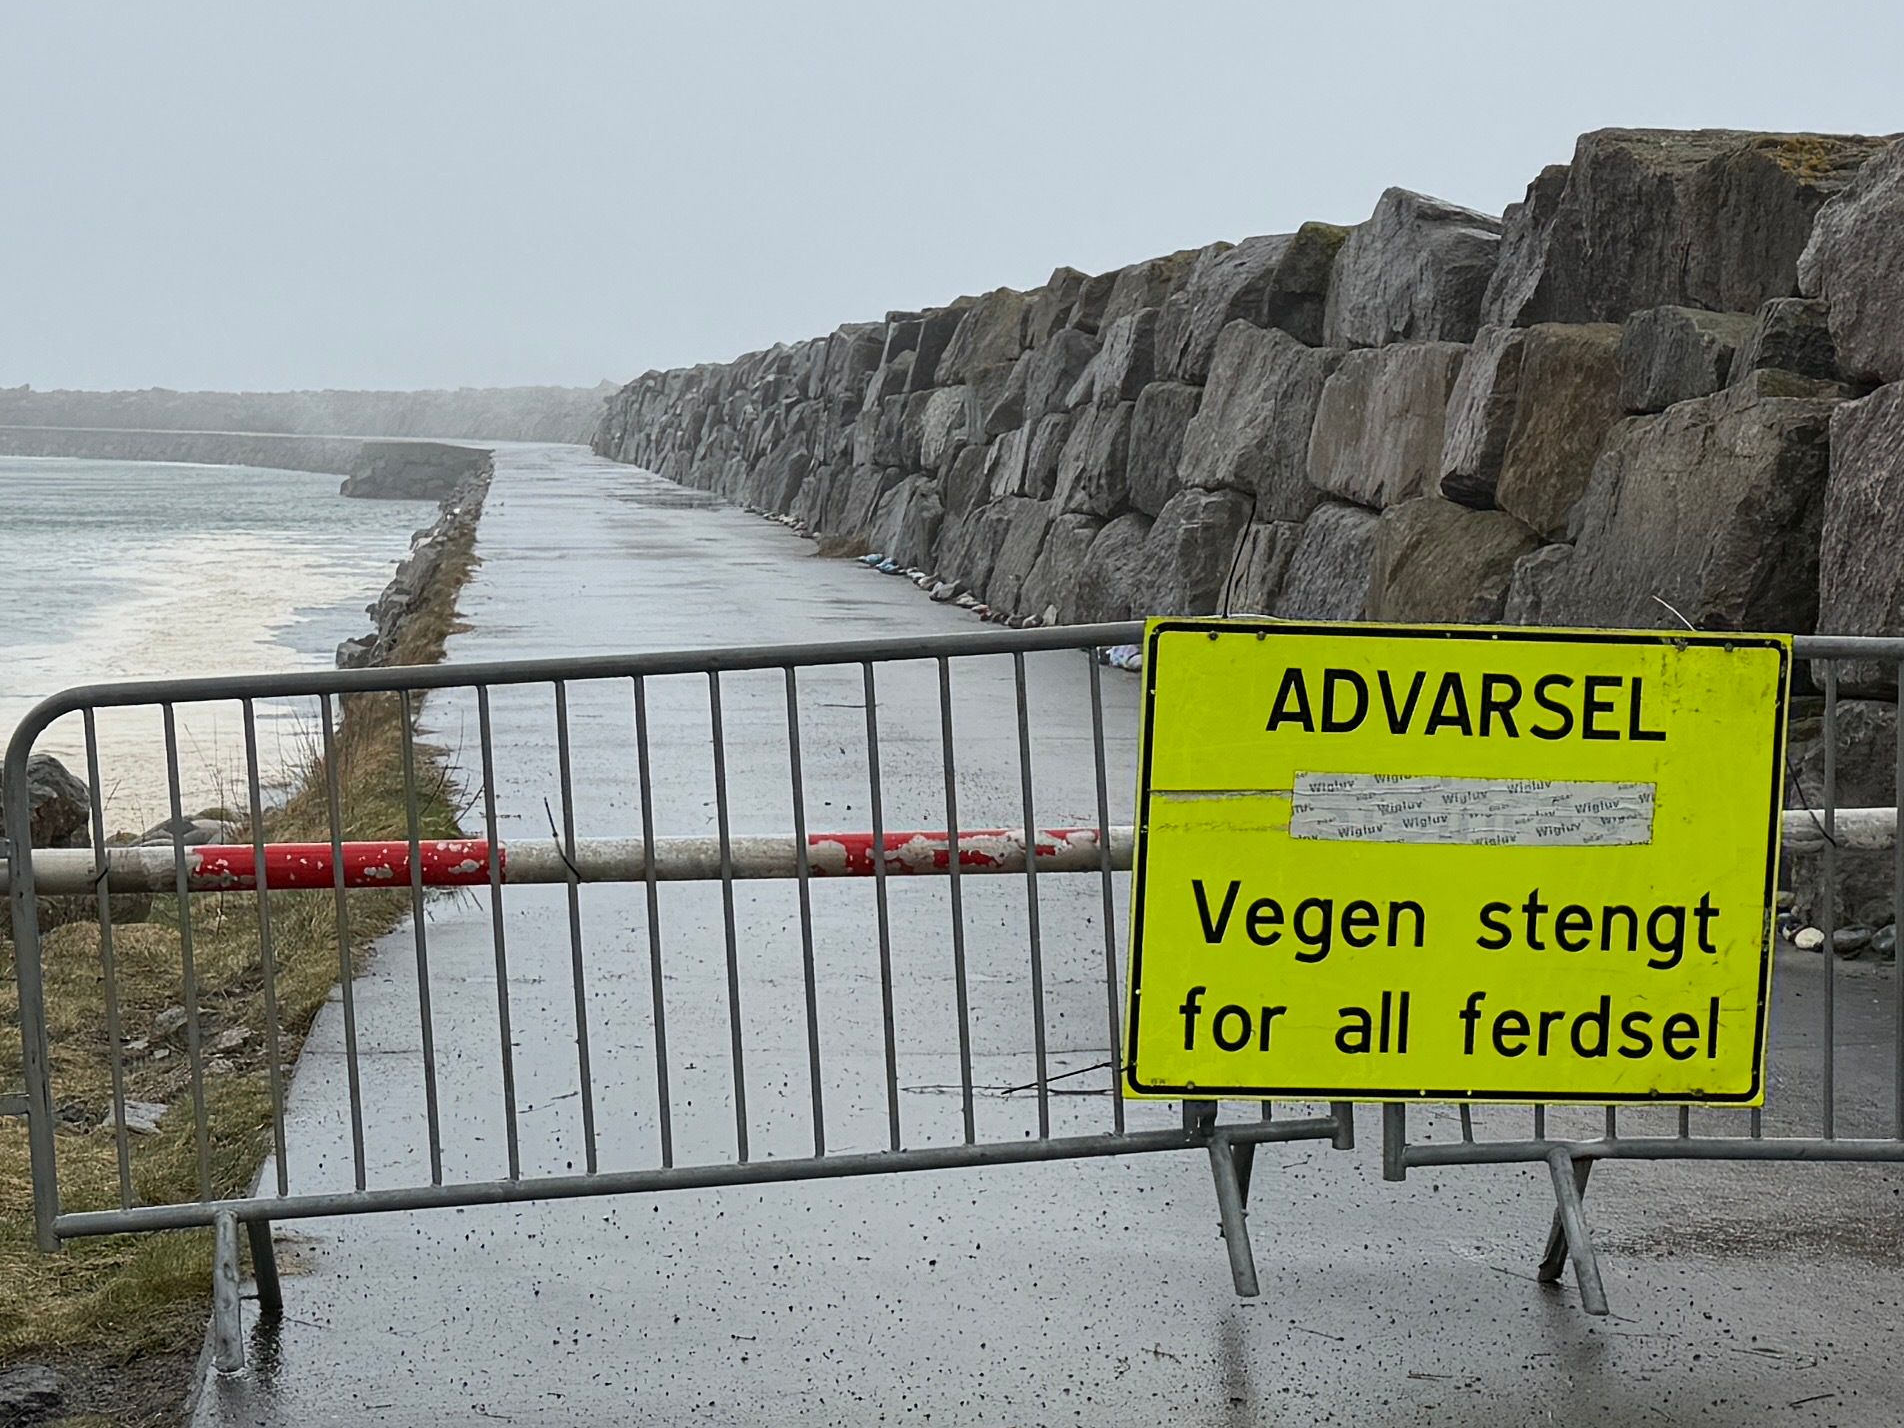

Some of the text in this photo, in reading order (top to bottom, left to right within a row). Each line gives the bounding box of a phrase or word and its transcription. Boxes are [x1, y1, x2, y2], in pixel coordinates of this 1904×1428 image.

[1265, 667, 1667, 742] ADVARSEL
[1191, 879, 1720, 971] Vegen stengt
[1179, 985, 1720, 1061] for all ferdsel
